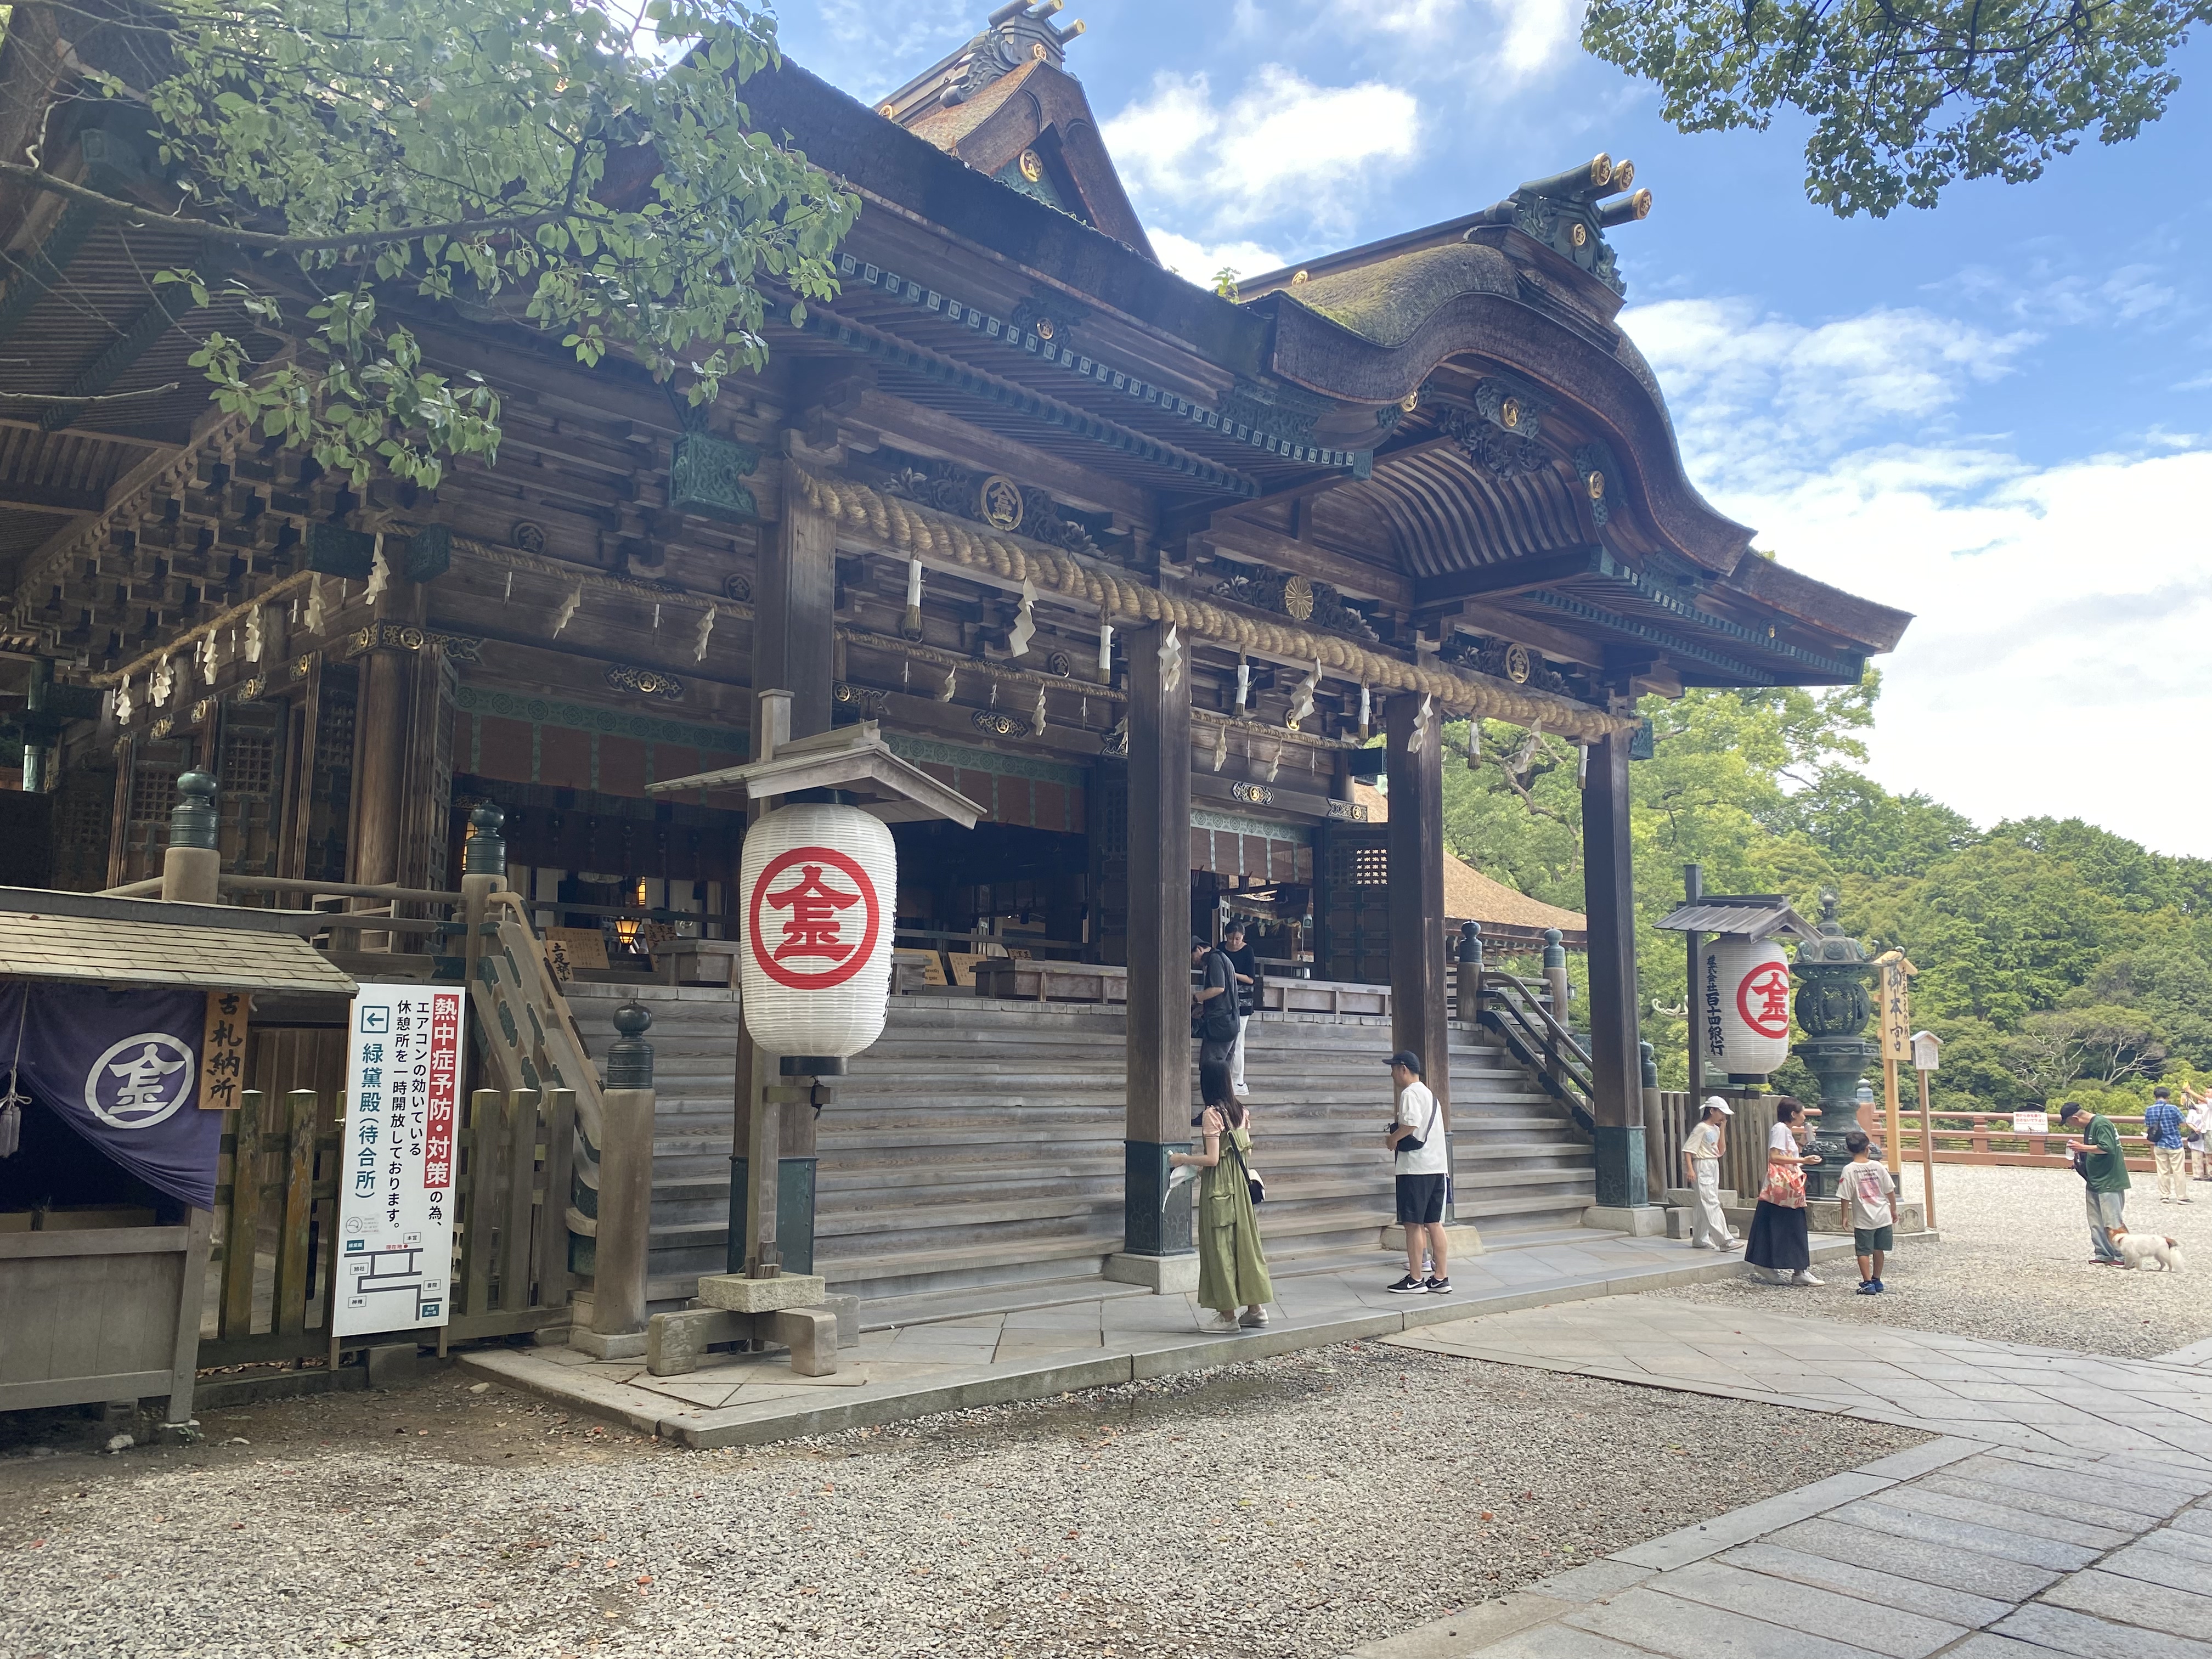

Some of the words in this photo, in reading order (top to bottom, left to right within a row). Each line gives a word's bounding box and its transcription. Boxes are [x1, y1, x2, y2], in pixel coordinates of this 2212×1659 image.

[765, 865, 862, 962] 金
[206, 993, 243, 1107] 古札納所
[1706, 955, 1725, 1056] 株式会社百十四銀行
[1751, 972, 1789, 1023] 金
[108, 1042, 186, 1115] 金
[387, 1000, 411, 1228] 休憩所を一時開放しております。
[409, 1002, 430, 1156] エアコンの効いている
[426, 998, 458, 1226] 熱中症予防・対策の為、
